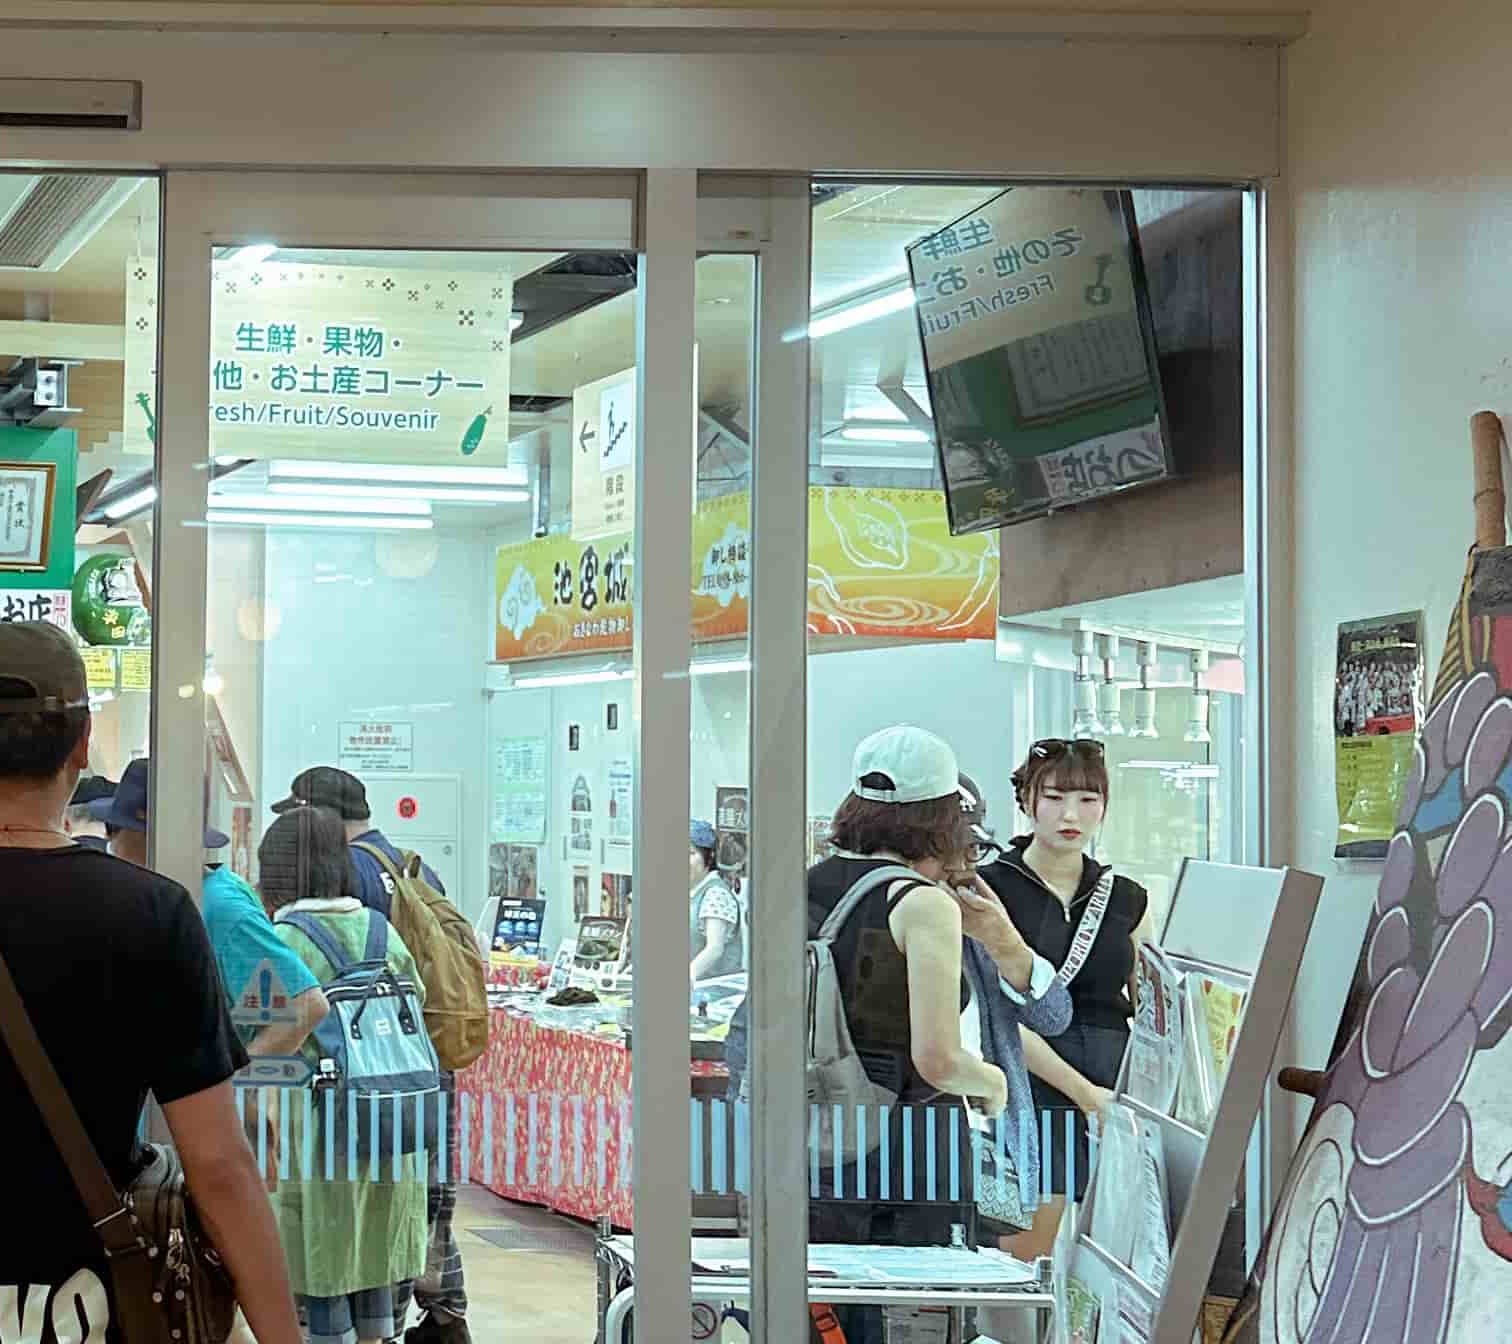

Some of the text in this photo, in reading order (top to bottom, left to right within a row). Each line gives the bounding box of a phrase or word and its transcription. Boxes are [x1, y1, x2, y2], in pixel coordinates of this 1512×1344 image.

[235, 322, 401, 358] 生鮮・果物・
[213, 360, 484, 397] 他・お土産コーナー
